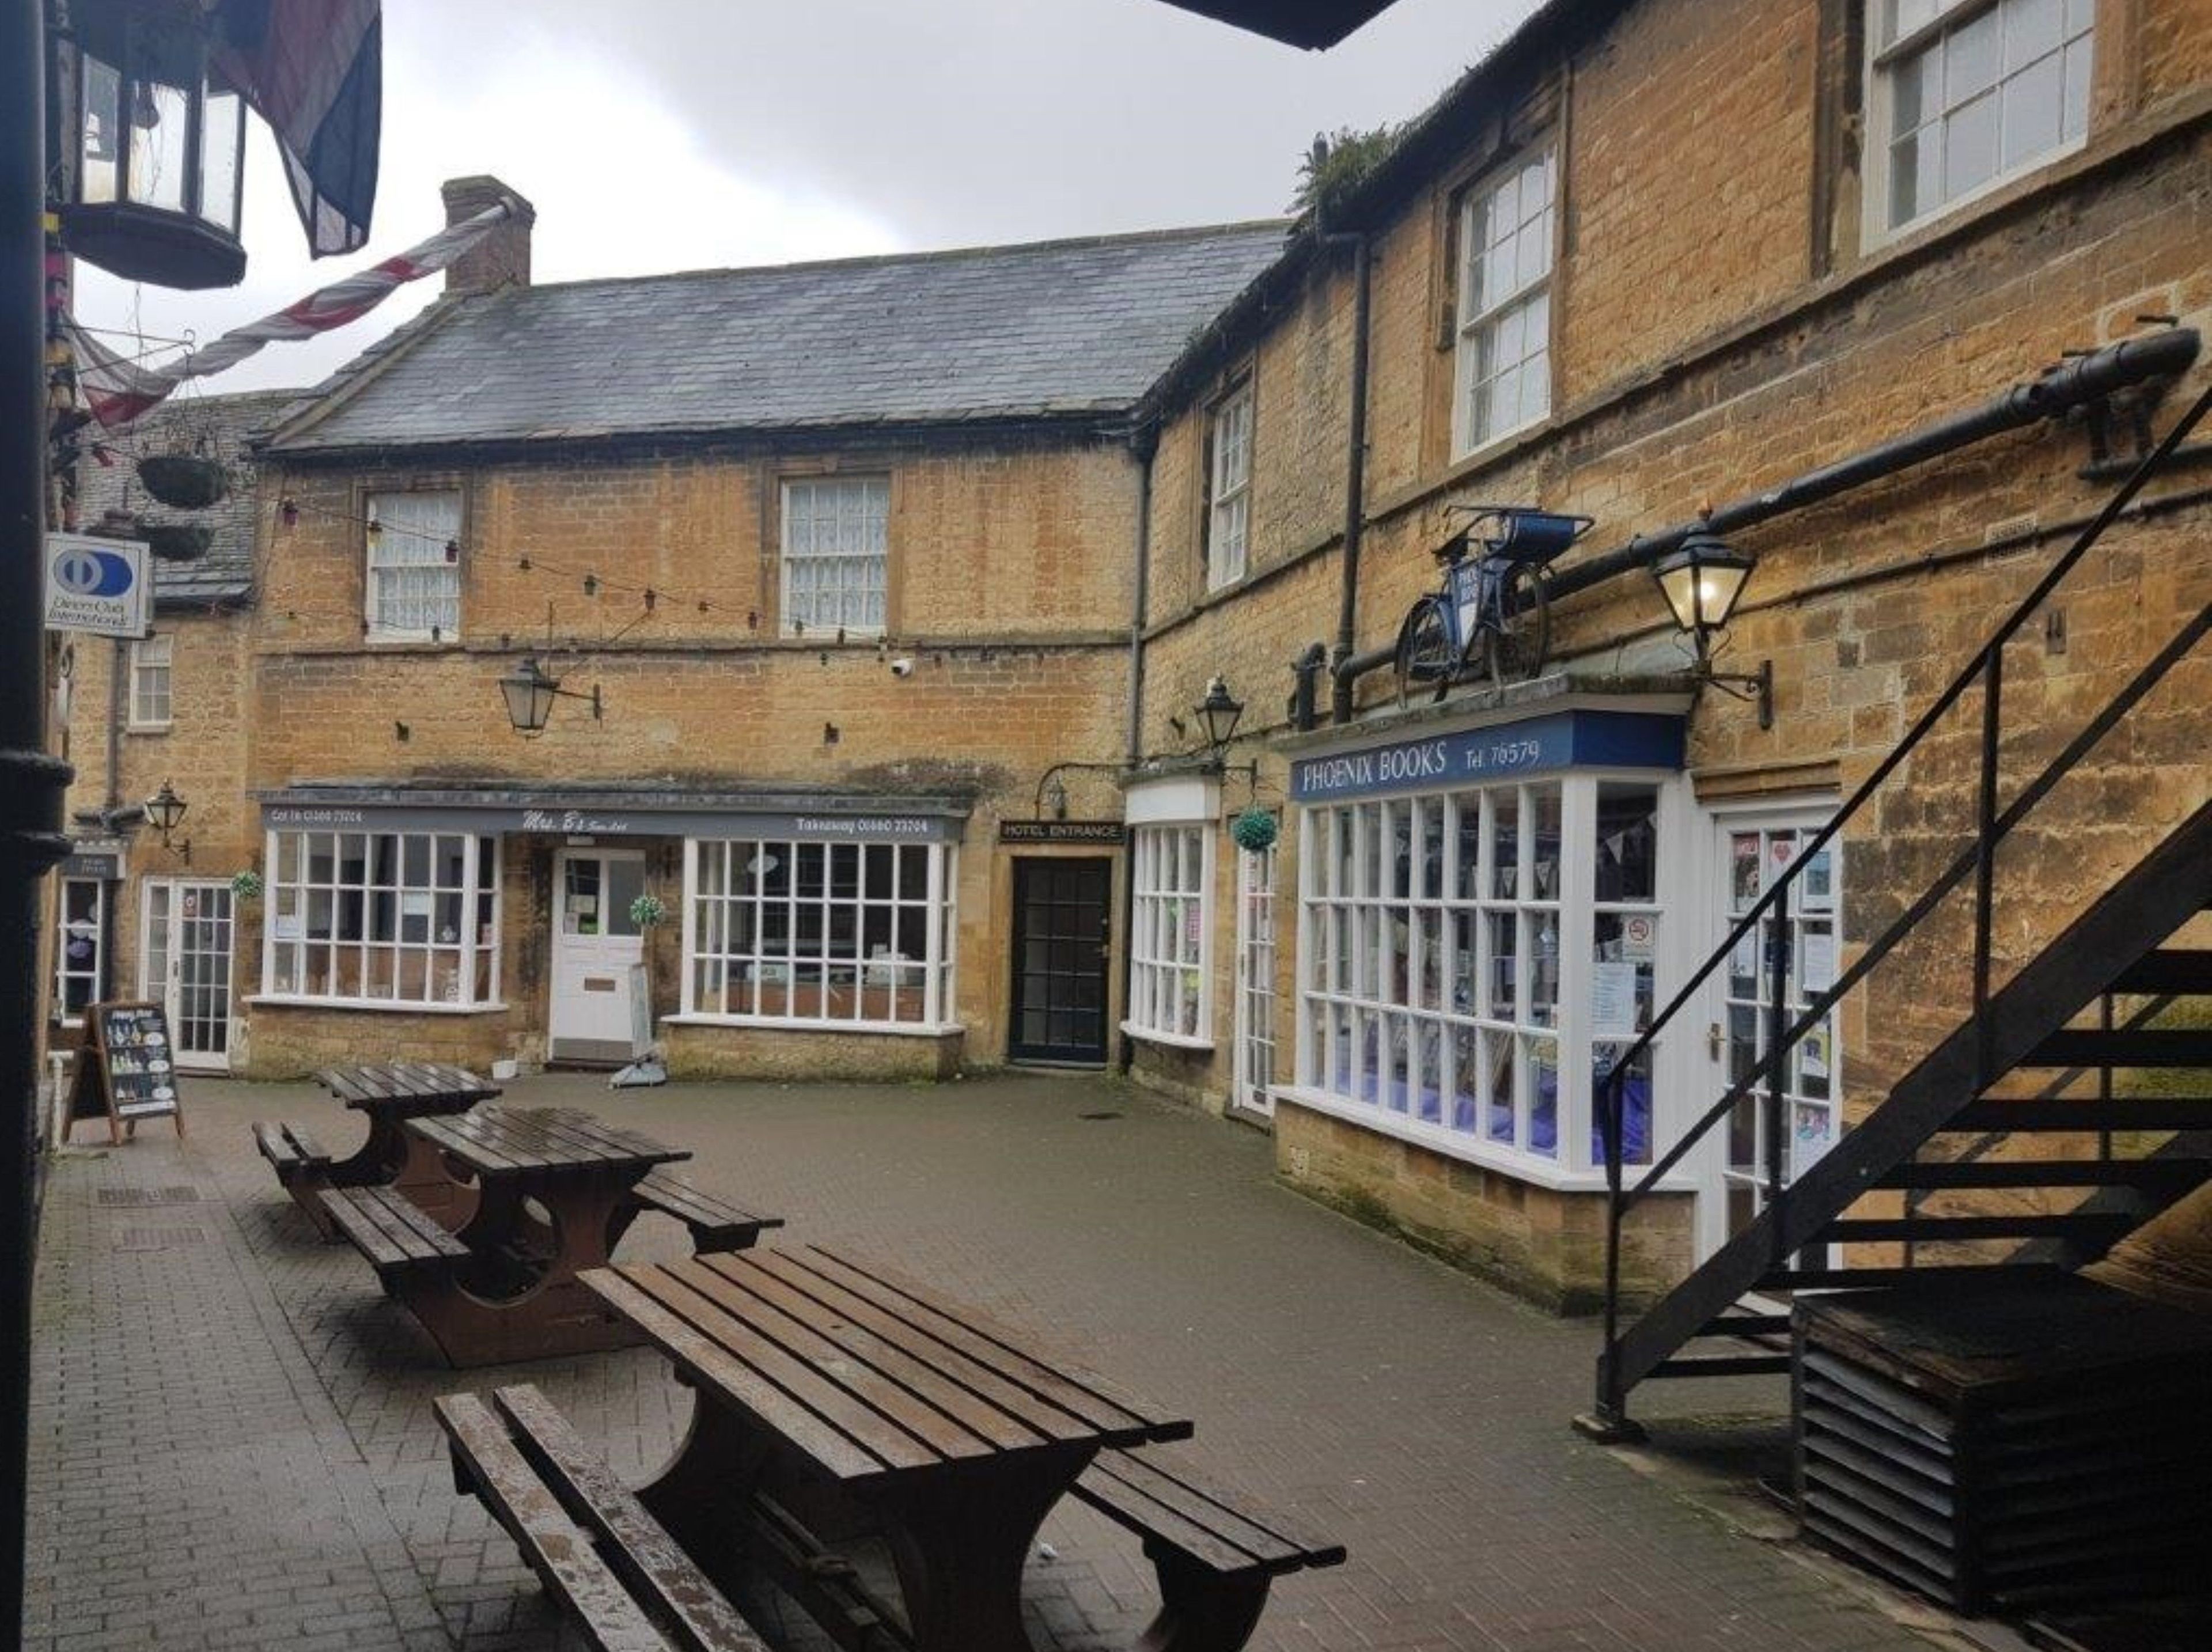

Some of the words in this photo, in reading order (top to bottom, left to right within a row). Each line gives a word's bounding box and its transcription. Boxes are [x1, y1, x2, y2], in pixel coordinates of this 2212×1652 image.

[1302, 756, 1373, 791] PHOENIX
[1380, 741, 1446, 781] BOOKS
[1491, 740, 1540, 764] 76579
[796, 818, 855, 834] Takeaway
[1005, 824, 1047, 836] HOTEL
[1050, 824, 1118, 838] ENTRANCE
